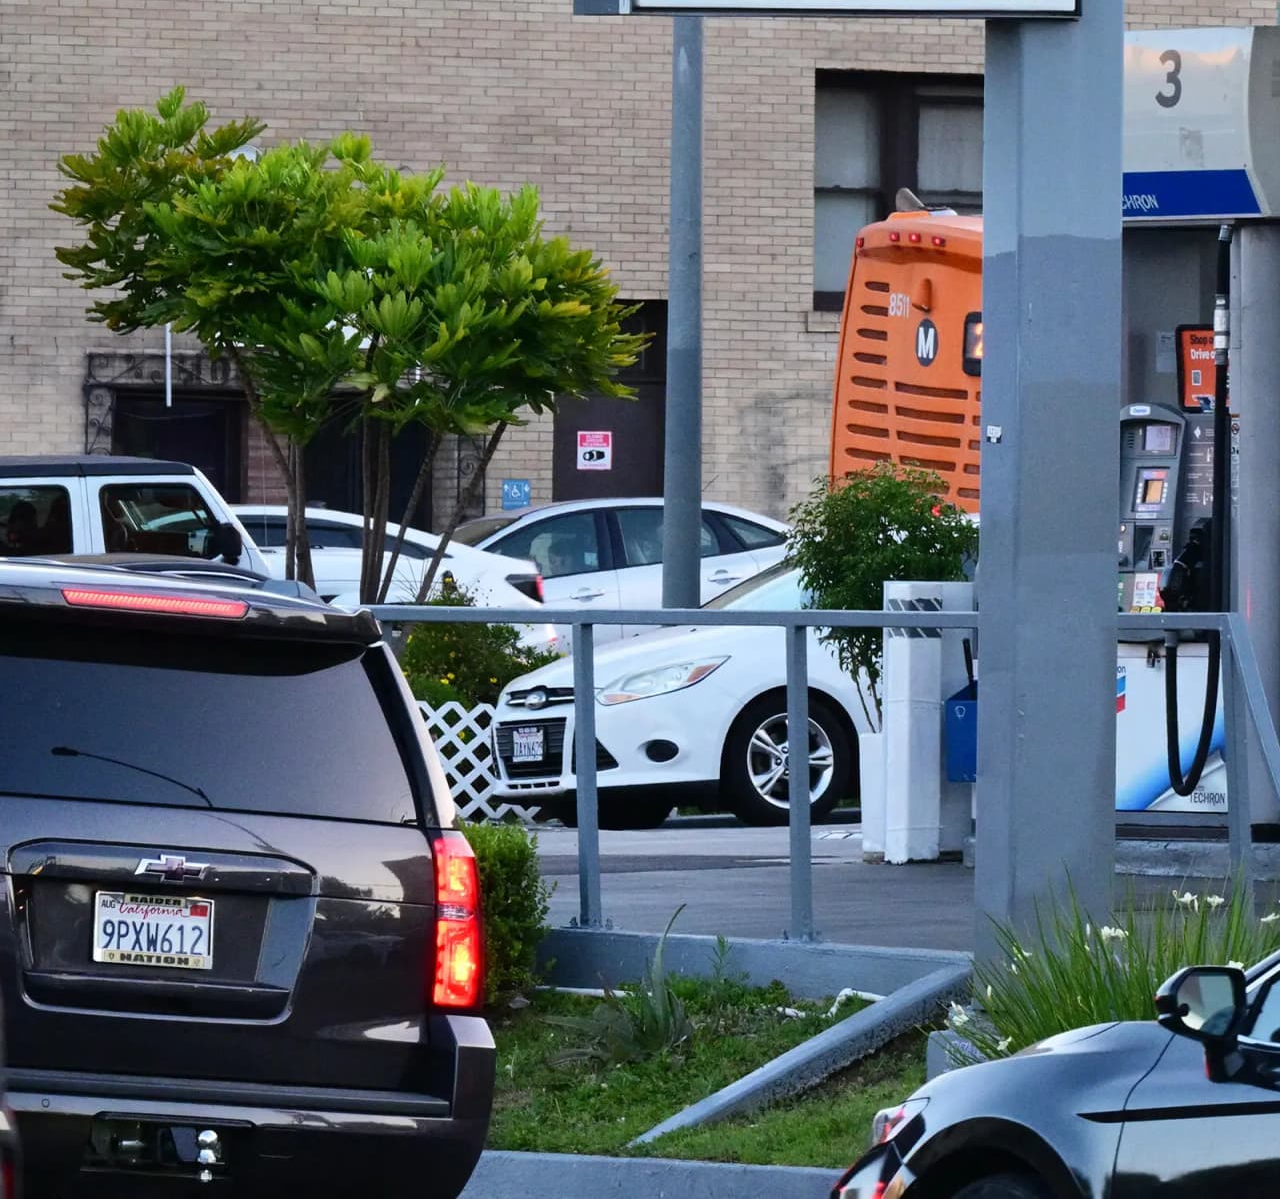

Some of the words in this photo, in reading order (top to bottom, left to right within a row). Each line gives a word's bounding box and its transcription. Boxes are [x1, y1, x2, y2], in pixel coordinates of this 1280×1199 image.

[1155, 49, 1182, 108] 3
[1122, 194, 1159, 212] CHRON
[917, 327, 934, 359] M
[1190, 334, 1207, 346] Shop
[1190, 349, 1209, 360] Drive
[1190, 792, 1226, 807] TECHRON
[130, 896, 182, 905] RAIDER
[101, 899, 116, 909] AUG
[119, 902, 185, 919] California
[101, 919, 204, 955] 9PXW612
[120, 952, 190, 966] NATION
